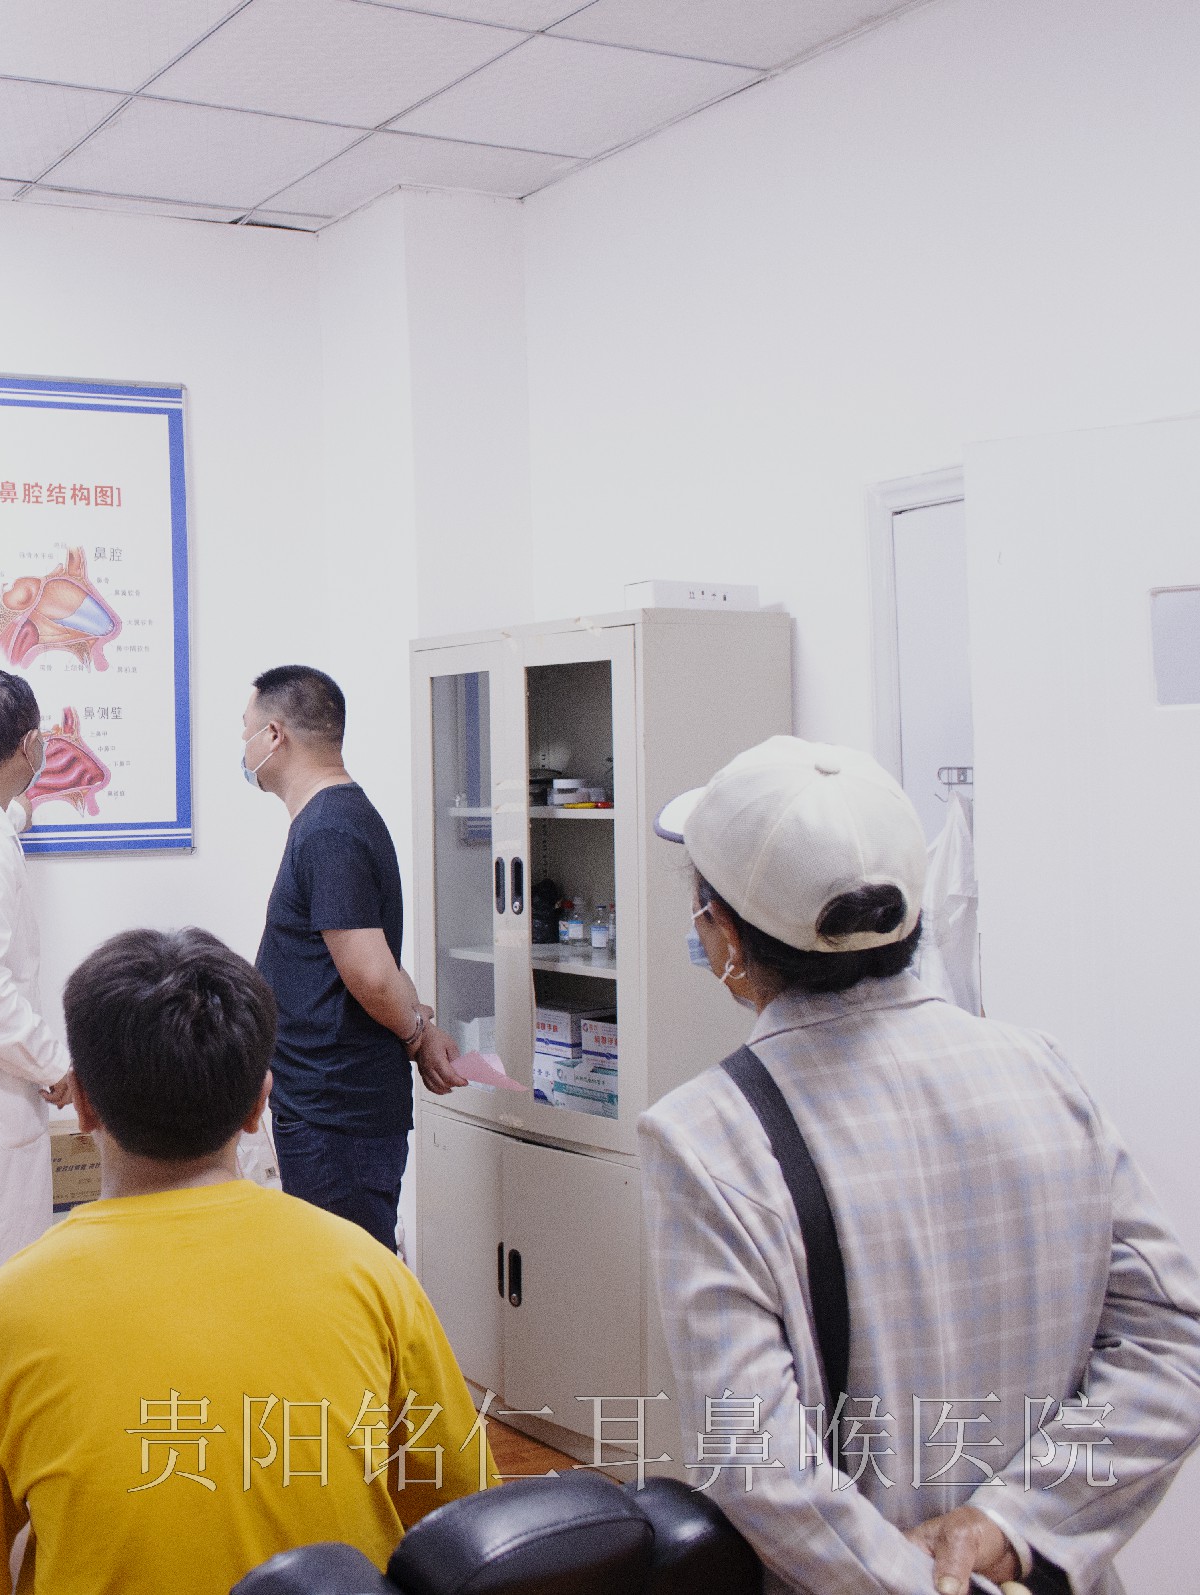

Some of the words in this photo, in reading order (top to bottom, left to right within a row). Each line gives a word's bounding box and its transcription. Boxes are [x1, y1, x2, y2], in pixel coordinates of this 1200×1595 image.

[93, 546, 123, 562] 鼻腔
[84, 706, 122, 720] 鼻侧壁
